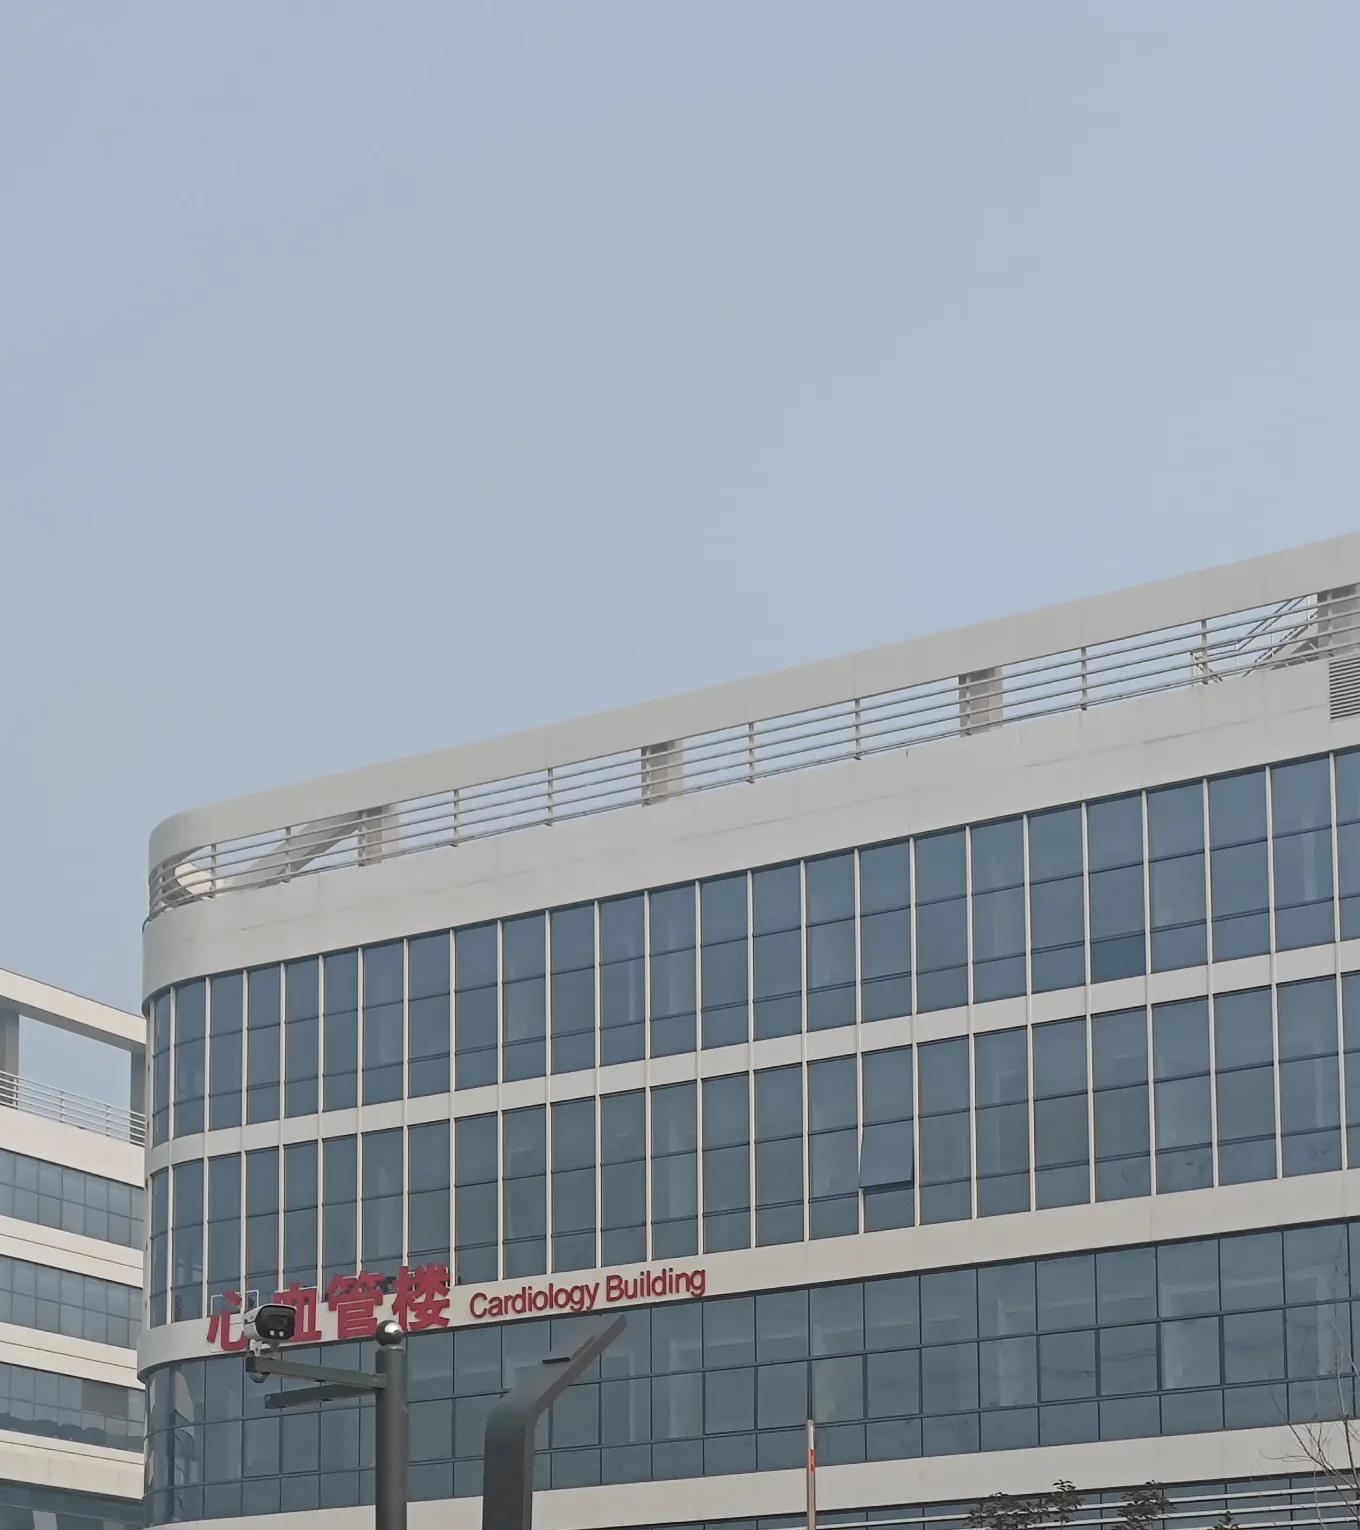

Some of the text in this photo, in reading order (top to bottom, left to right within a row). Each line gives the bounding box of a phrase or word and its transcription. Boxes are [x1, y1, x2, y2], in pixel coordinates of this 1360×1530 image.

[207, 1263, 451, 1351] 心血管楼
[470, 1267, 706, 1319] Cardiology Building
